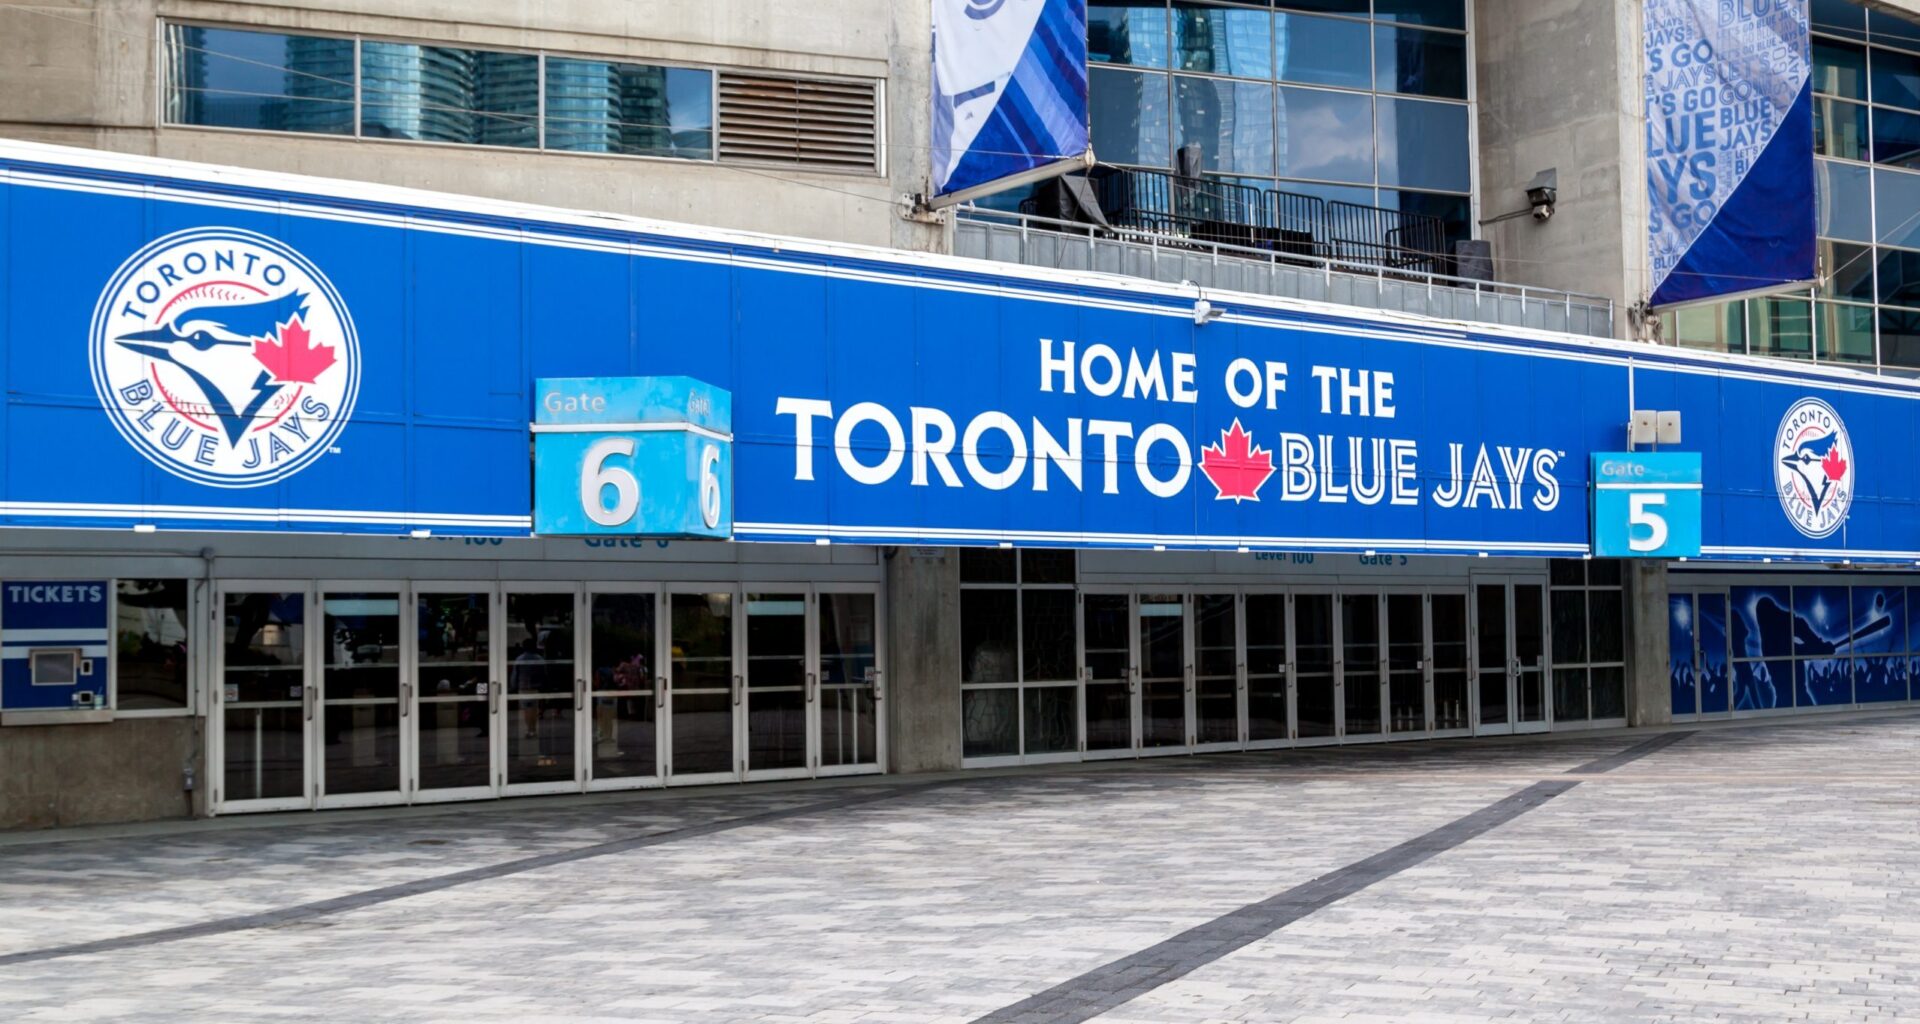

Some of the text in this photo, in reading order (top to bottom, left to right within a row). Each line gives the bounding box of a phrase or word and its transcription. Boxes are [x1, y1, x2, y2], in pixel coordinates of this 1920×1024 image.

[1646, 26, 1685, 48] JAYS
[1671, 38, 1713, 68] GO
[1660, 63, 1717, 92] JAYS
[1719, 79, 1752, 106] GO
[1683, 86, 1716, 113] GO
[1720, 96, 1771, 129] BLUE
[1720, 118, 1772, 151] JAYS
[1670, 200, 1717, 230] GO
[121, 249, 286, 321] TORONTO
[1039, 338, 1396, 418] HOME OF THE
[544, 392, 607, 413] Gate
[119, 379, 330, 469] BLUE JAYS
[1782, 409, 1831, 450] TORONTO
[775, 396, 1193, 499] TORONTO
[1279, 431, 1420, 506] BLUE
[581, 437, 640, 526] 6
[1601, 461, 1645, 477] Gate
[701, 444, 721, 529] 6
[1783, 480, 1847, 529] BLUE JAYS
[1629, 493, 1668, 552] 5
[8, 585, 102, 603] TICKETS
